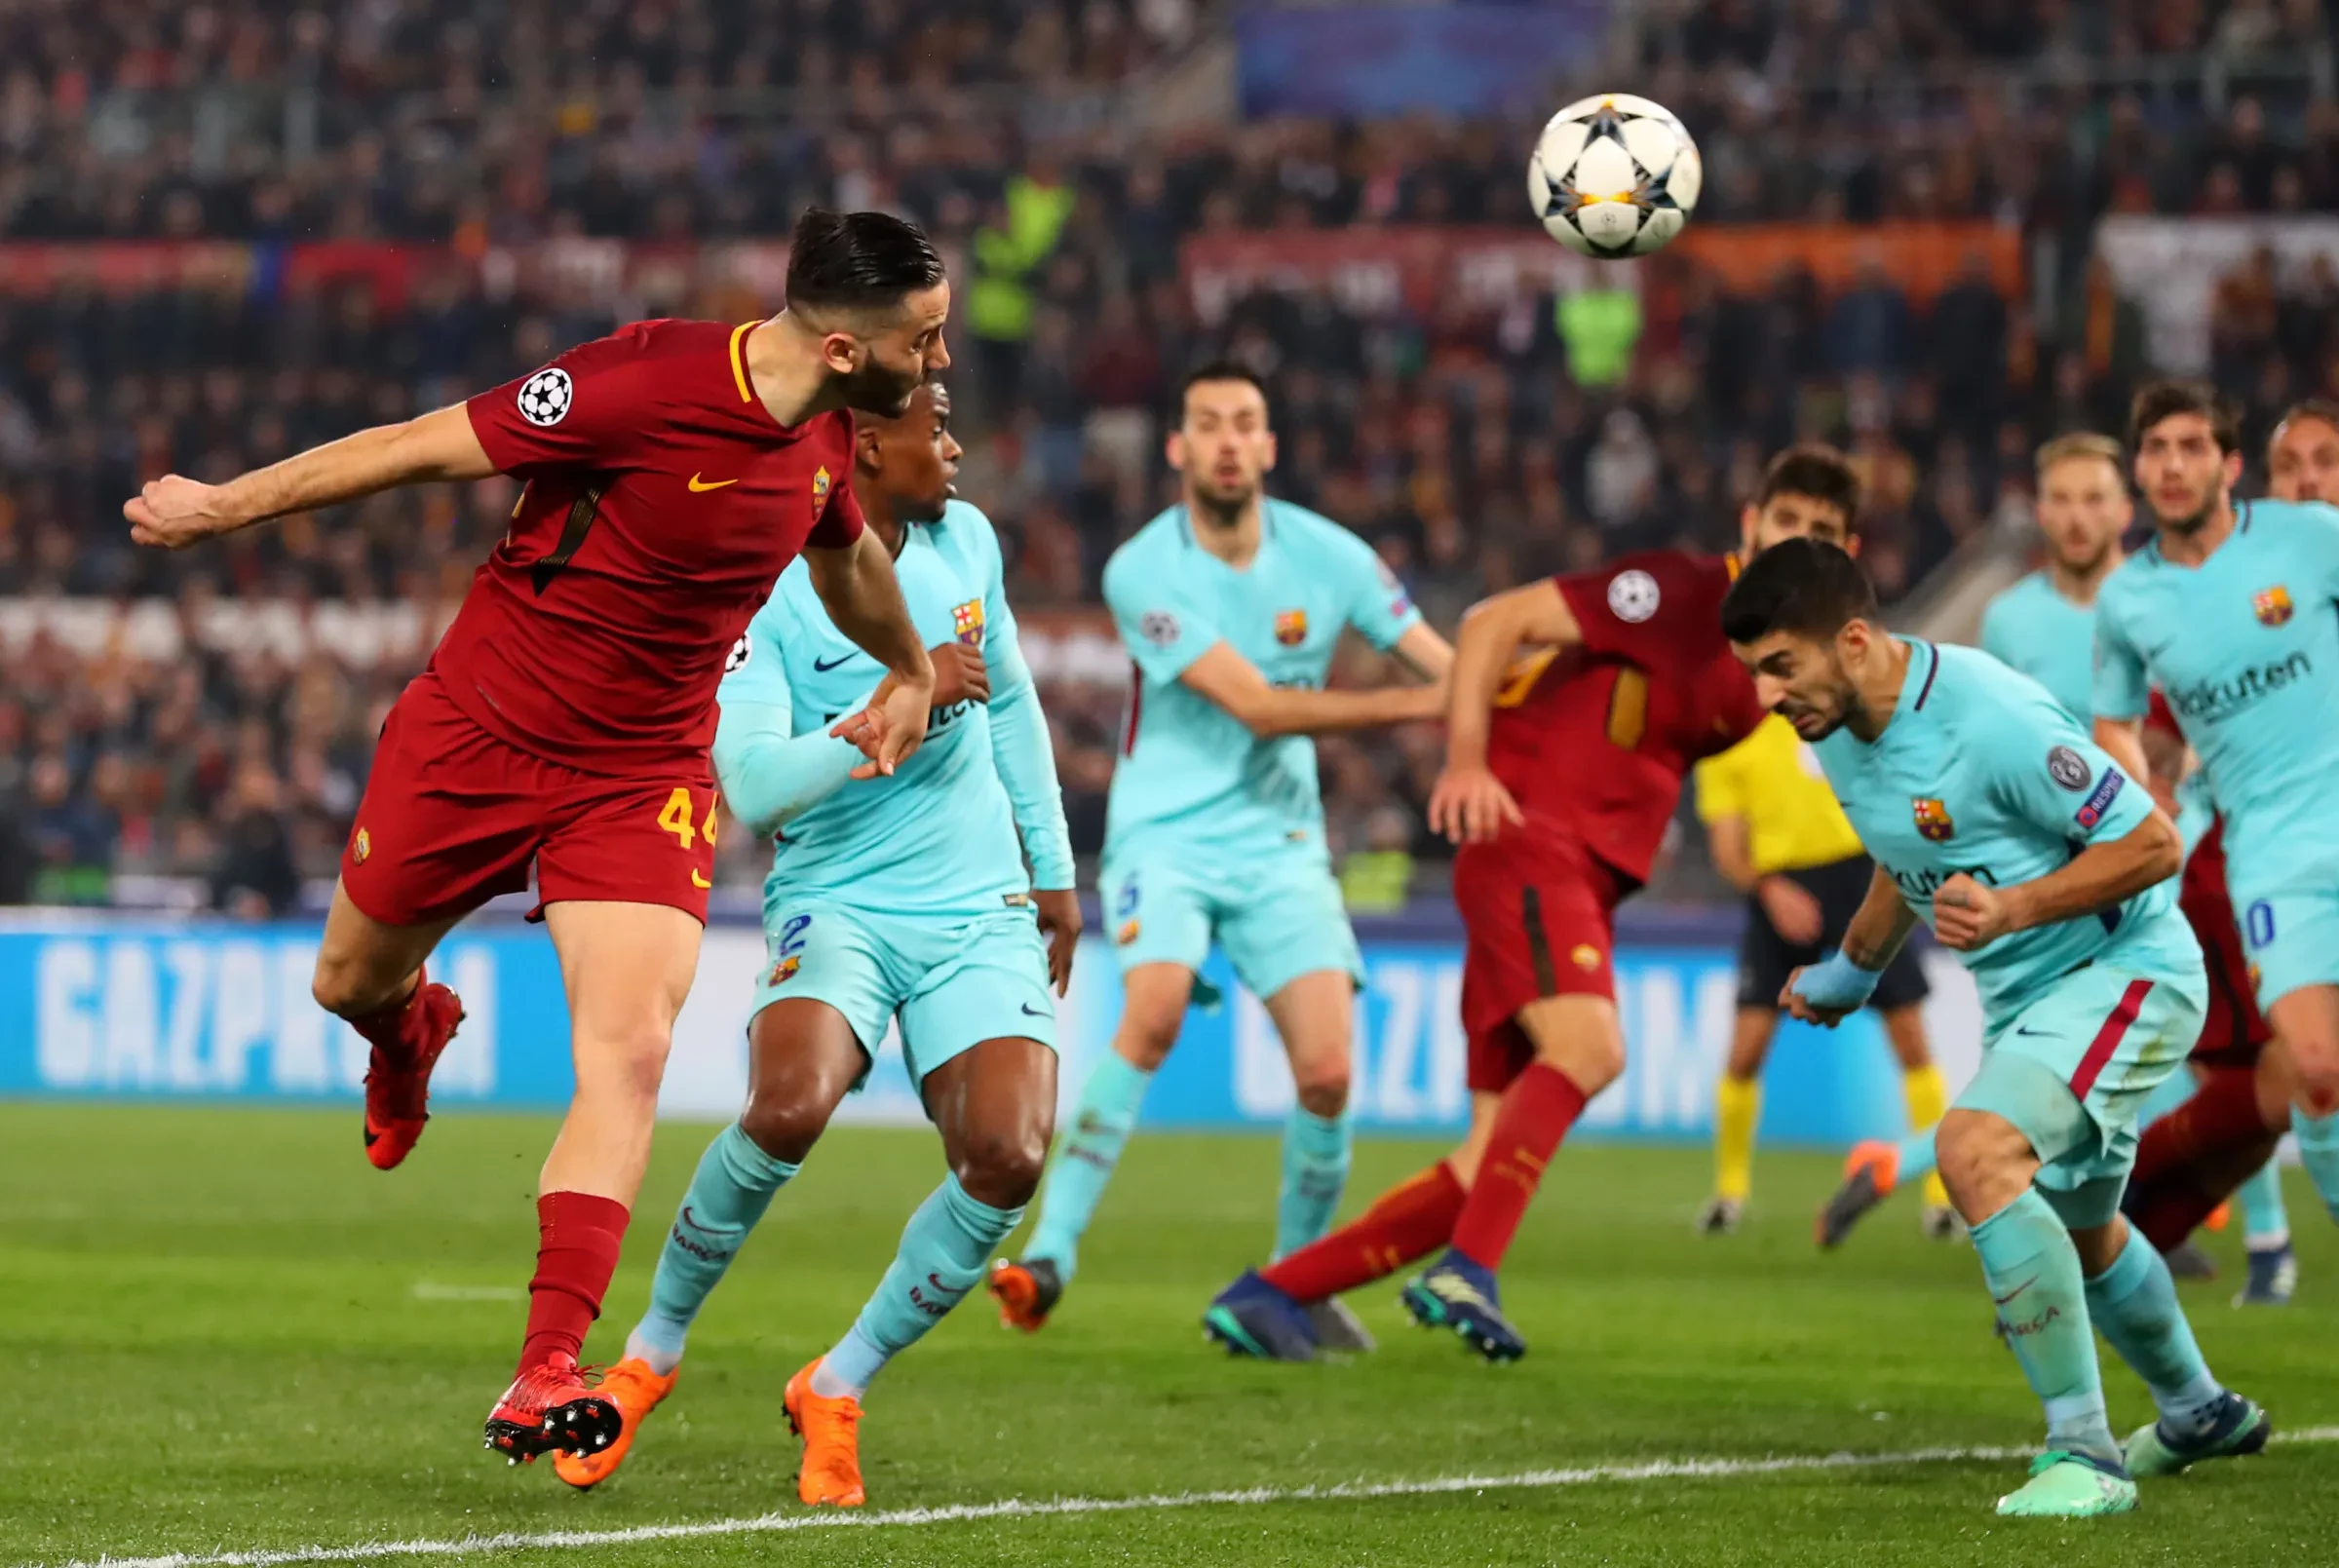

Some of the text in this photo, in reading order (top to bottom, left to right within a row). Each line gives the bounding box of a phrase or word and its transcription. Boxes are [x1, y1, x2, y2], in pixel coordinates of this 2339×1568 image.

[781, 914, 812, 957] 2
[2236, 898, 2276, 951] 0
[39, 941, 499, 1095] GAZPRM
